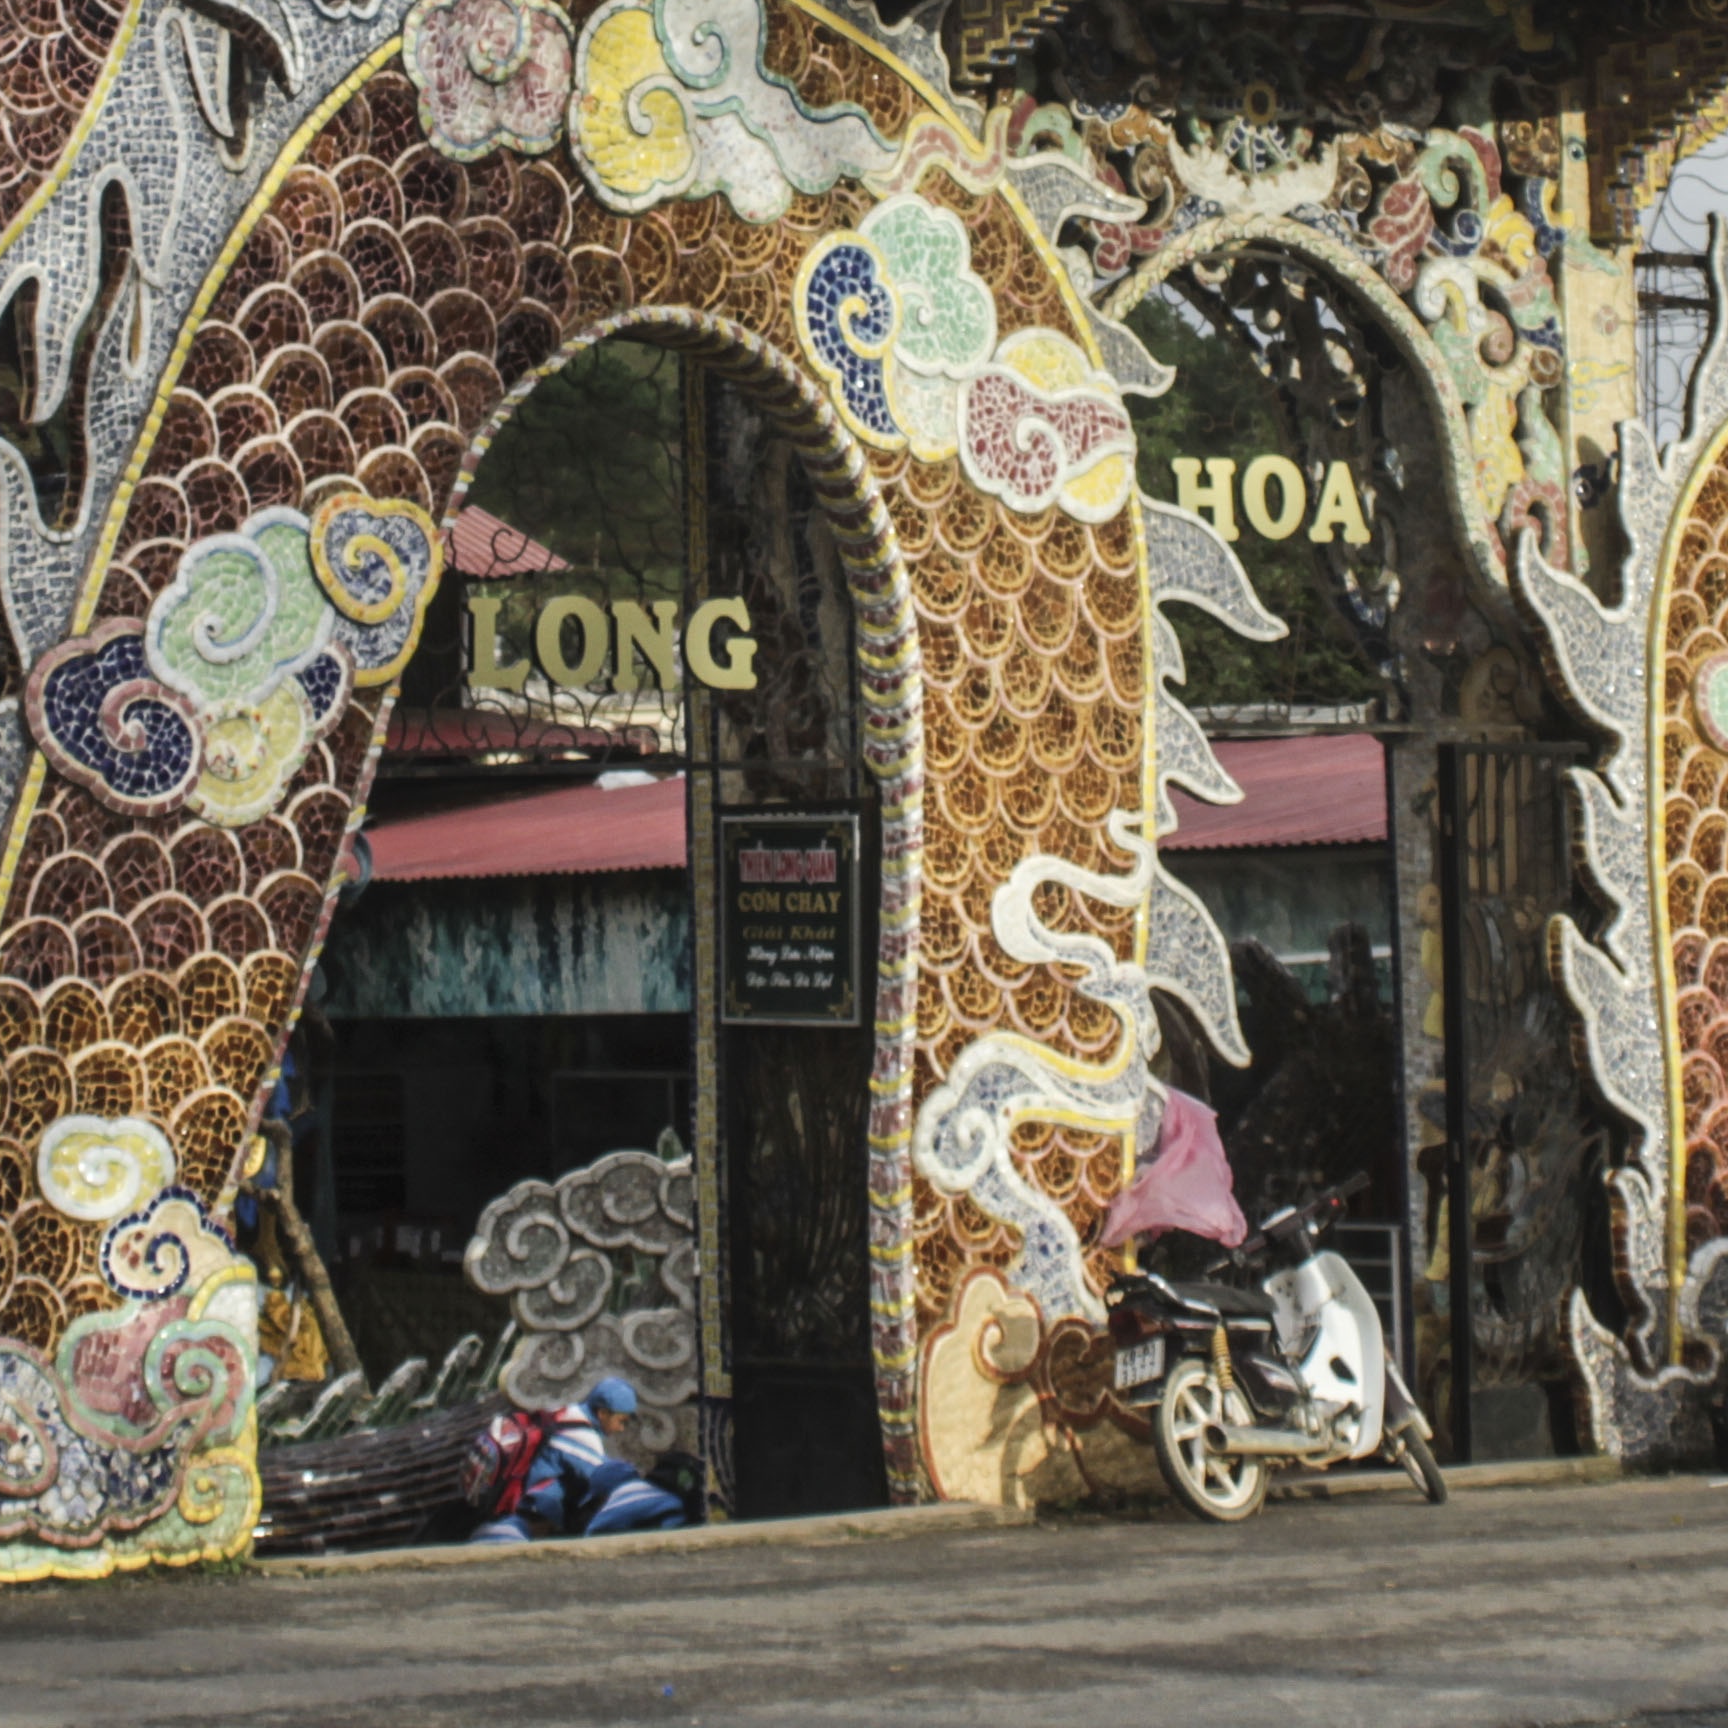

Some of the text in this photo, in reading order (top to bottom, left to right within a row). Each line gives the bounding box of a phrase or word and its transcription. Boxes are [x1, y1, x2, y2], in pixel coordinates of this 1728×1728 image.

[468, 595, 757, 690] LONG
[1171, 454, 1371, 543] HOA
[738, 888, 842, 913] CƠM CHAY
